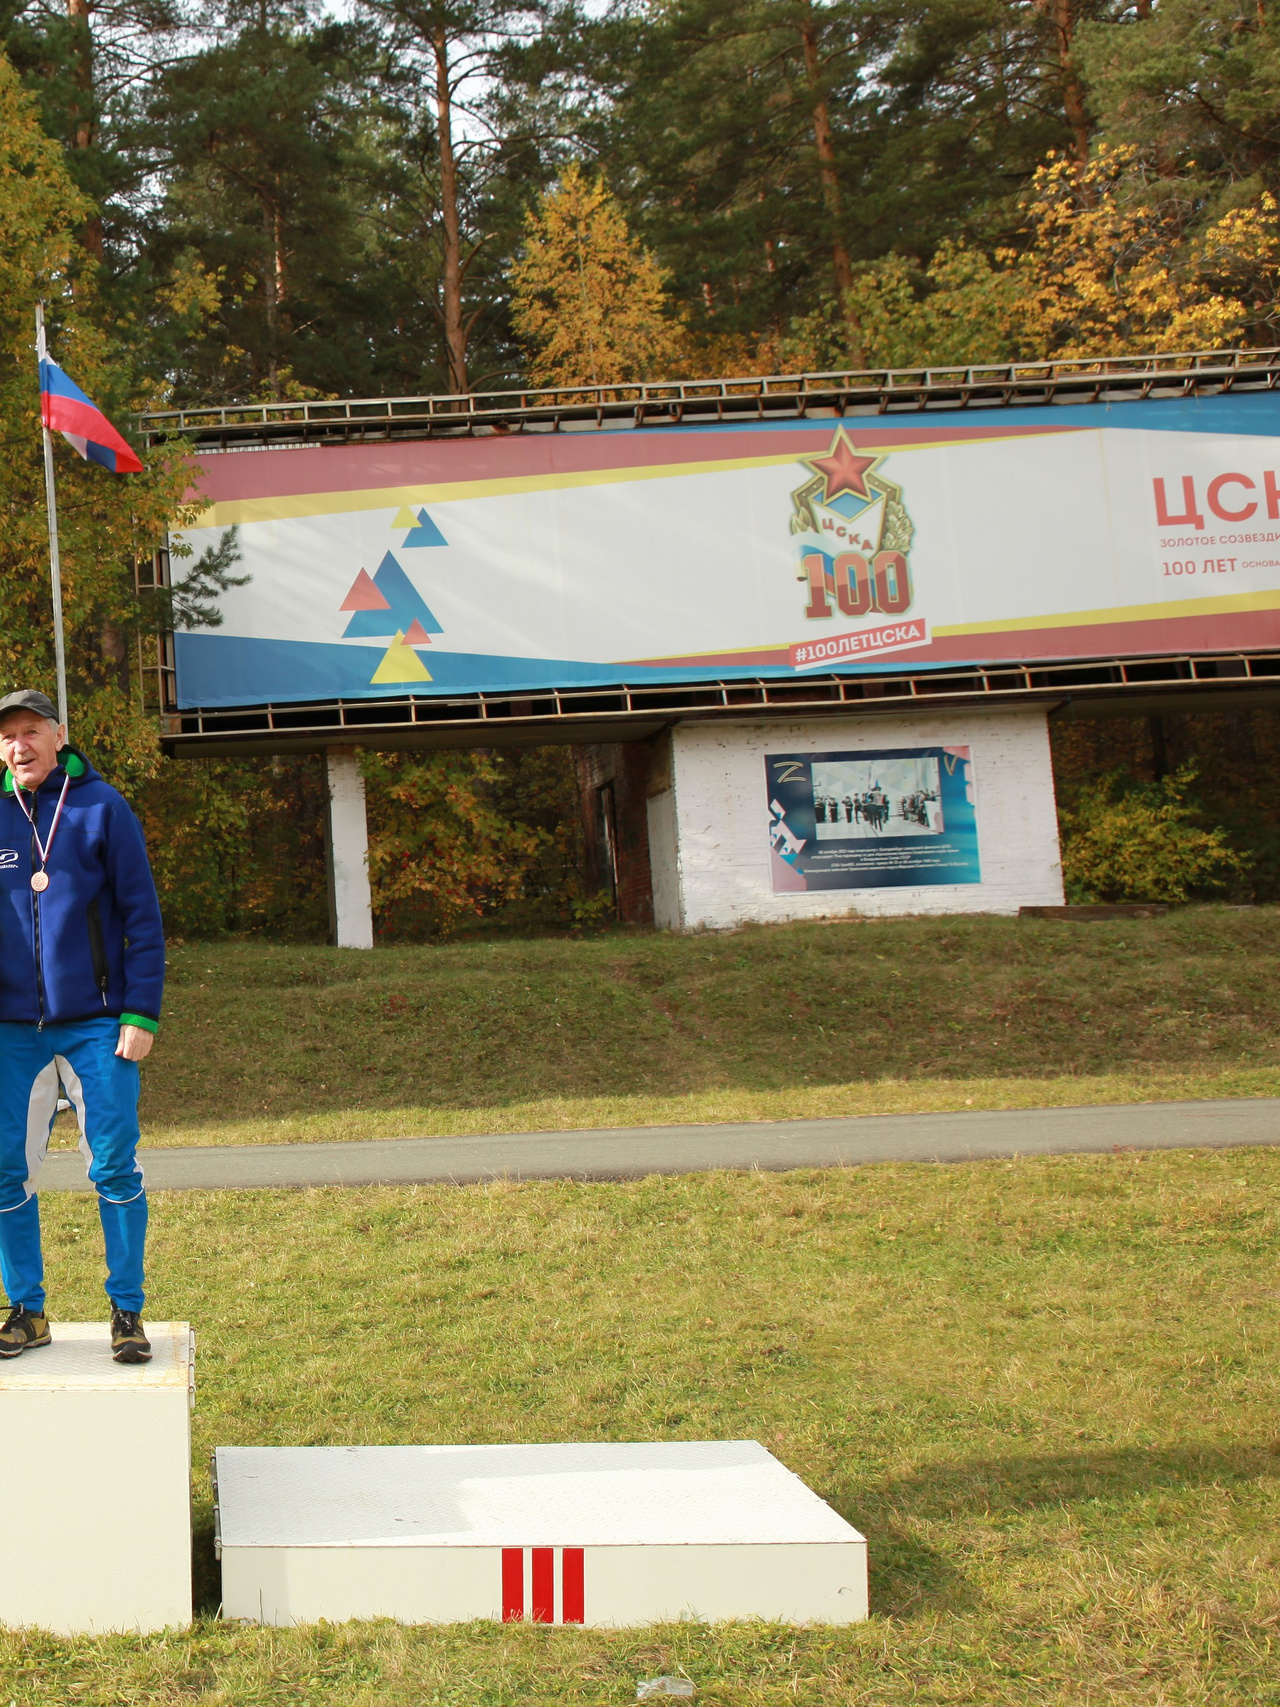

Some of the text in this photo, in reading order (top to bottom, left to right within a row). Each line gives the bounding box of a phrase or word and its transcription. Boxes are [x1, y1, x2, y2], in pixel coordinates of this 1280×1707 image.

[822, 518, 874, 550] ЦСКА
[1160, 536, 1216, 548] ЗОЛОТОЕ
[1162, 560, 1196, 576] 100
[1202, 558, 1237, 574] ЛЕТ
[801, 550, 911, 619] 100
[795, 624, 920, 662] #100ЛЕТЦСКА
